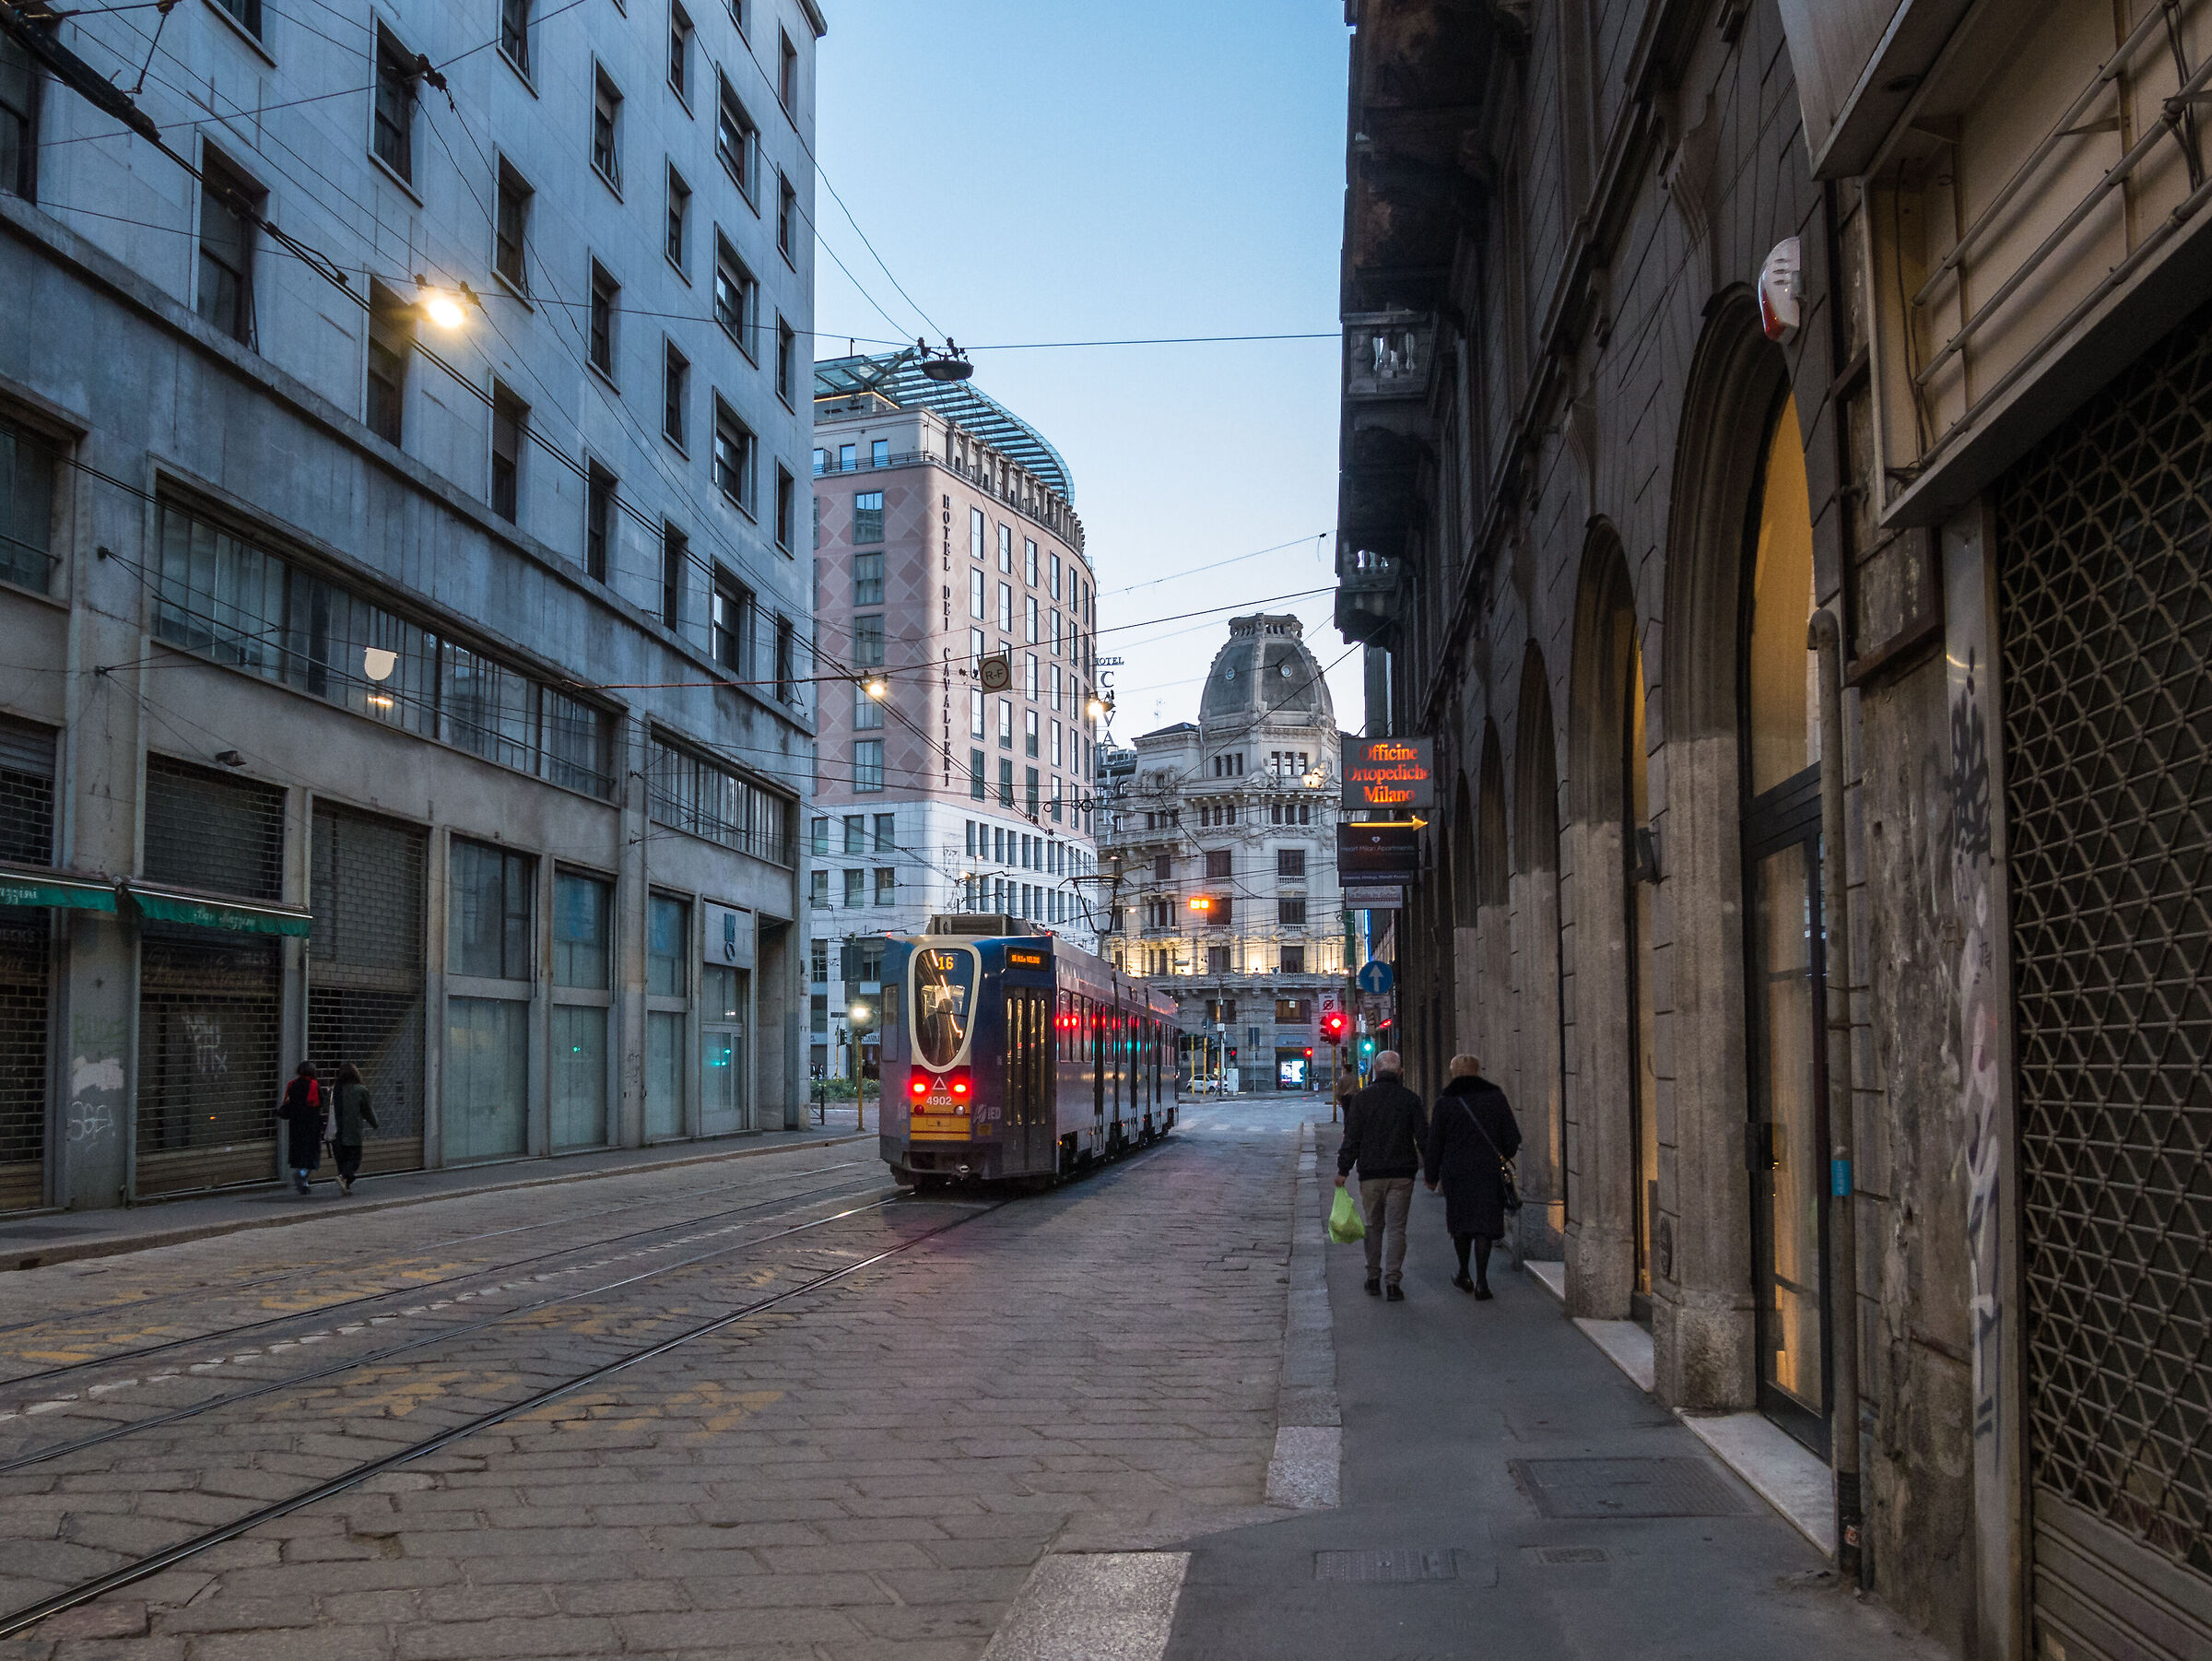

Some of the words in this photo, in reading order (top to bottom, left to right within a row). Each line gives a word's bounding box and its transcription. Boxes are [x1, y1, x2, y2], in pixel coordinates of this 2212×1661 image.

[942, 494, 951, 571] HOTEL
[942, 584, 951, 631] DEI
[985, 668, 1004, 680] R-F
[942, 646, 952, 787] CAVALIERI
[1359, 743, 1418, 761] Officine
[1345, 764, 1431, 785] Ortopediche
[1364, 786, 1416, 804] Milano
[0, 887, 38, 905] azzini
[938, 956, 954, 971] 16
[926, 1096, 952, 1106] 4902
